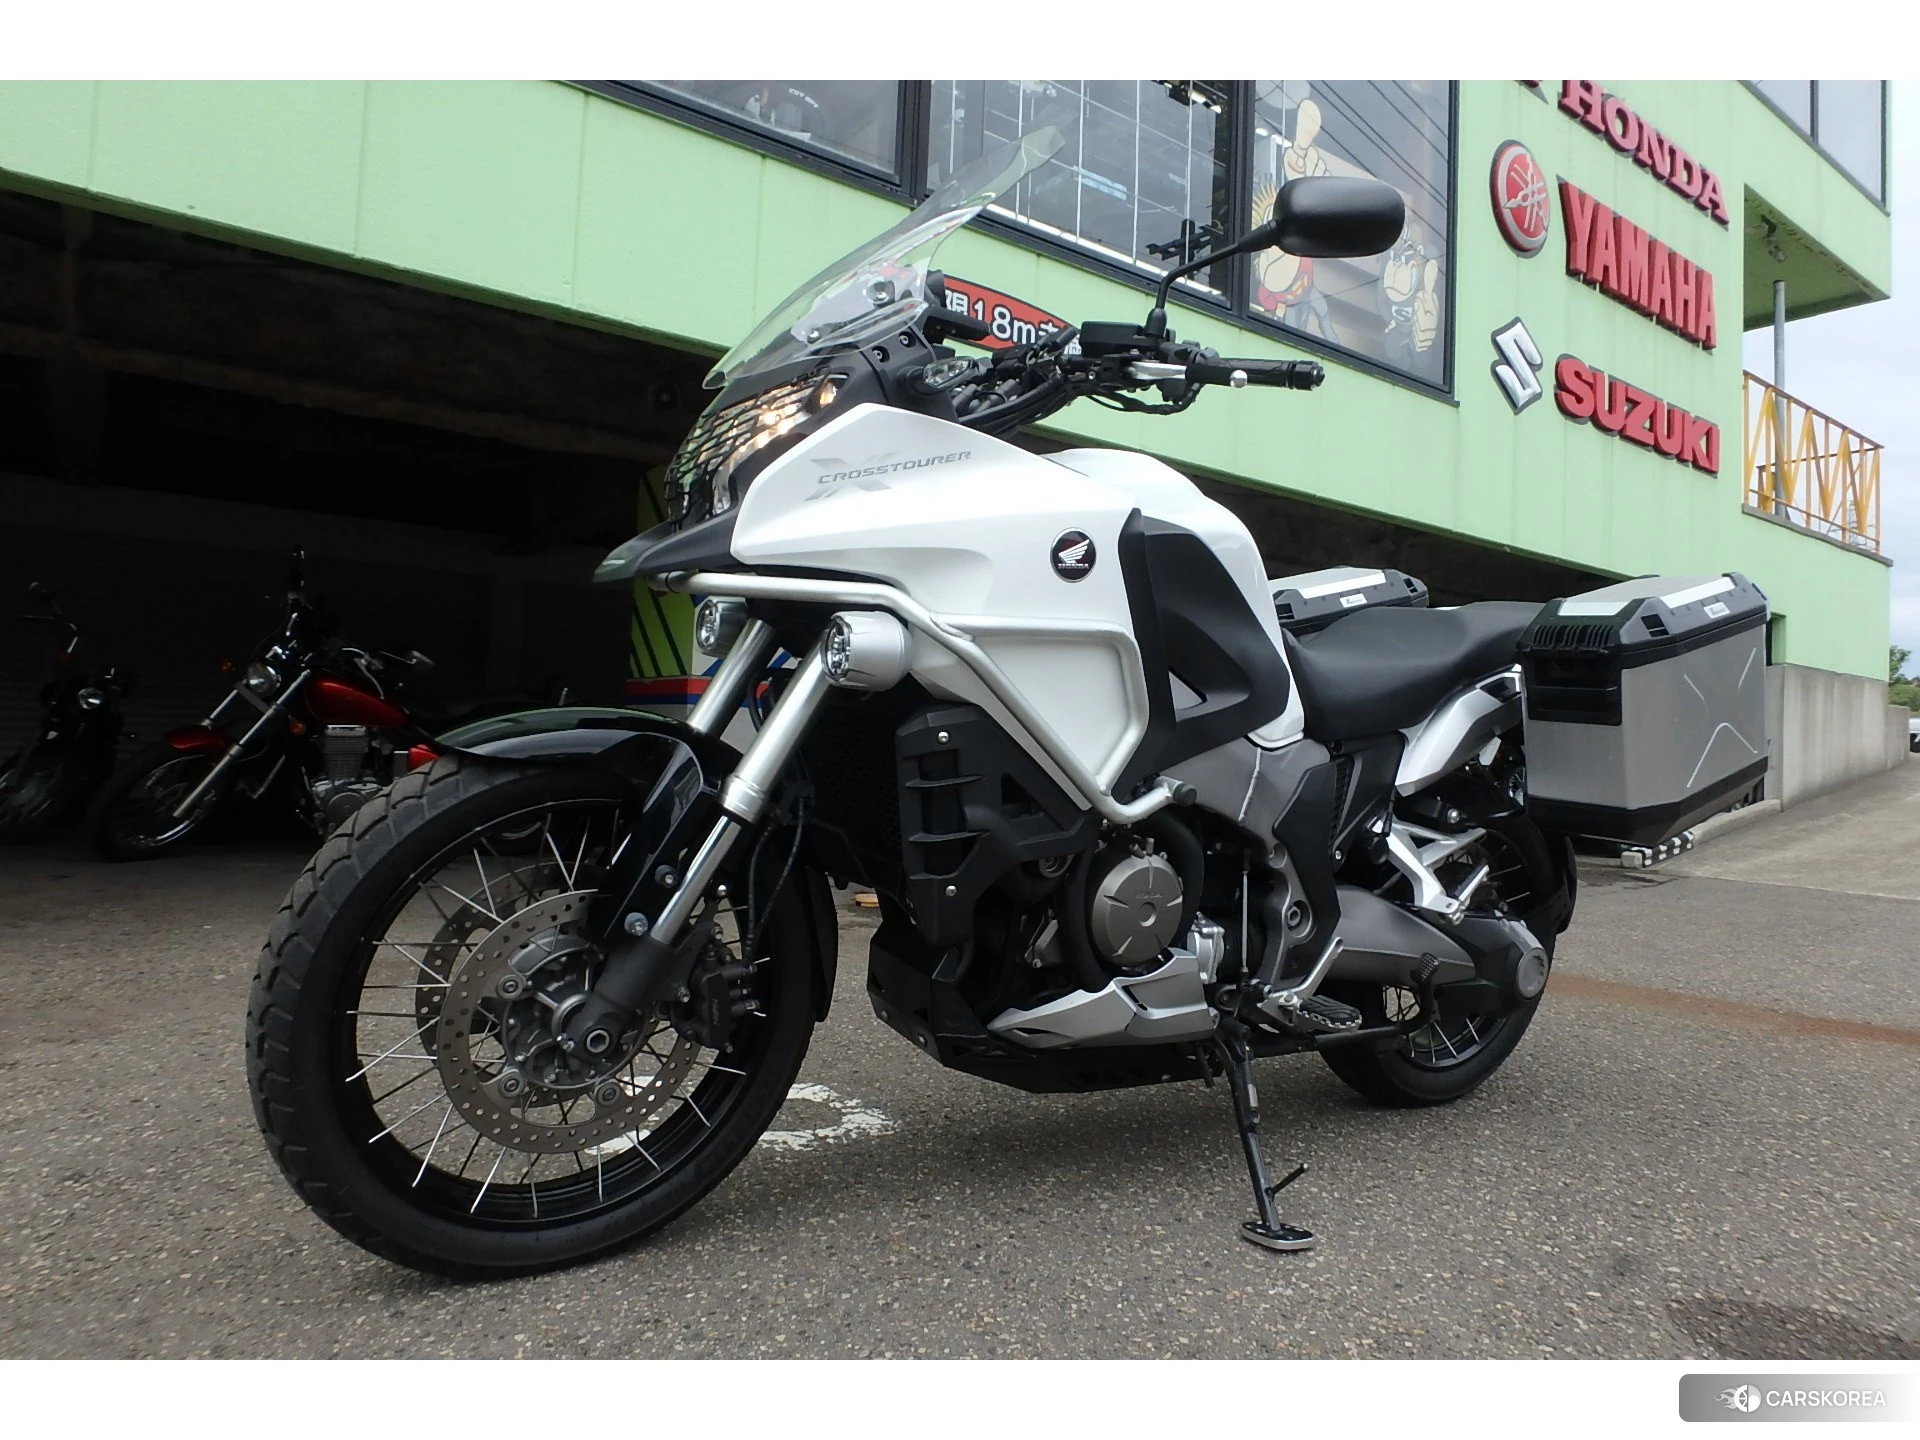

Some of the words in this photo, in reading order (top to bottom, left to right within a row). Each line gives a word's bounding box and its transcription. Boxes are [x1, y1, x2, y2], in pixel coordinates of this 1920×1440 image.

[1558, 80, 1729, 225] HONDA
[1558, 179, 1717, 350] YAMAHA
[817, 451, 972, 484] CROSSTOURER
[1555, 358, 1720, 474] SUZUKI
